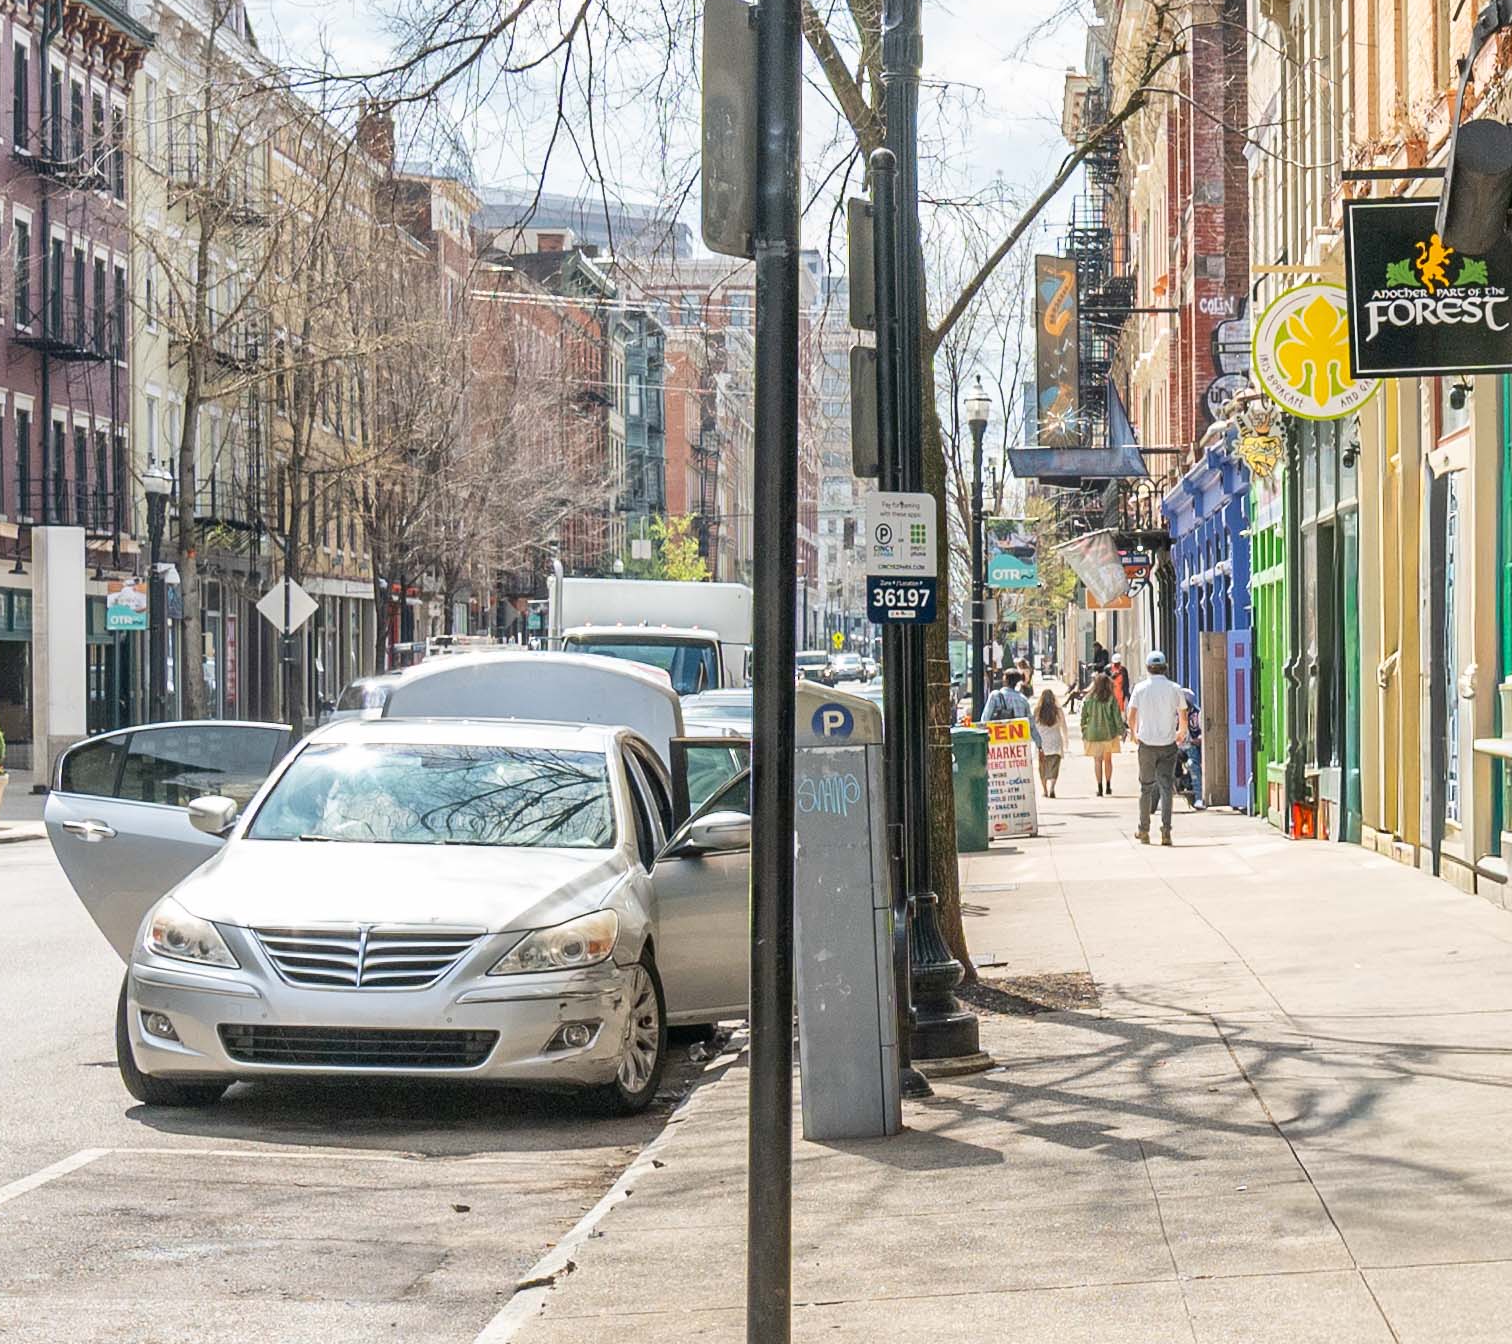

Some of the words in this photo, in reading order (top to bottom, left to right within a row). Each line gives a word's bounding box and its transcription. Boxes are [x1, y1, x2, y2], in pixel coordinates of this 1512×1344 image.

[1436, 288, 1465, 297] PART
[1467, 288, 1481, 296] OF
[1364, 295, 1510, 342] FOREST
[1340, 391, 1359, 408] AND
[992, 568, 1021, 581] OTR
[873, 588, 930, 607] 36197
[110, 615, 133, 625] OTR
[822, 710, 846, 737] P
[988, 745, 1027, 760] MARKET
